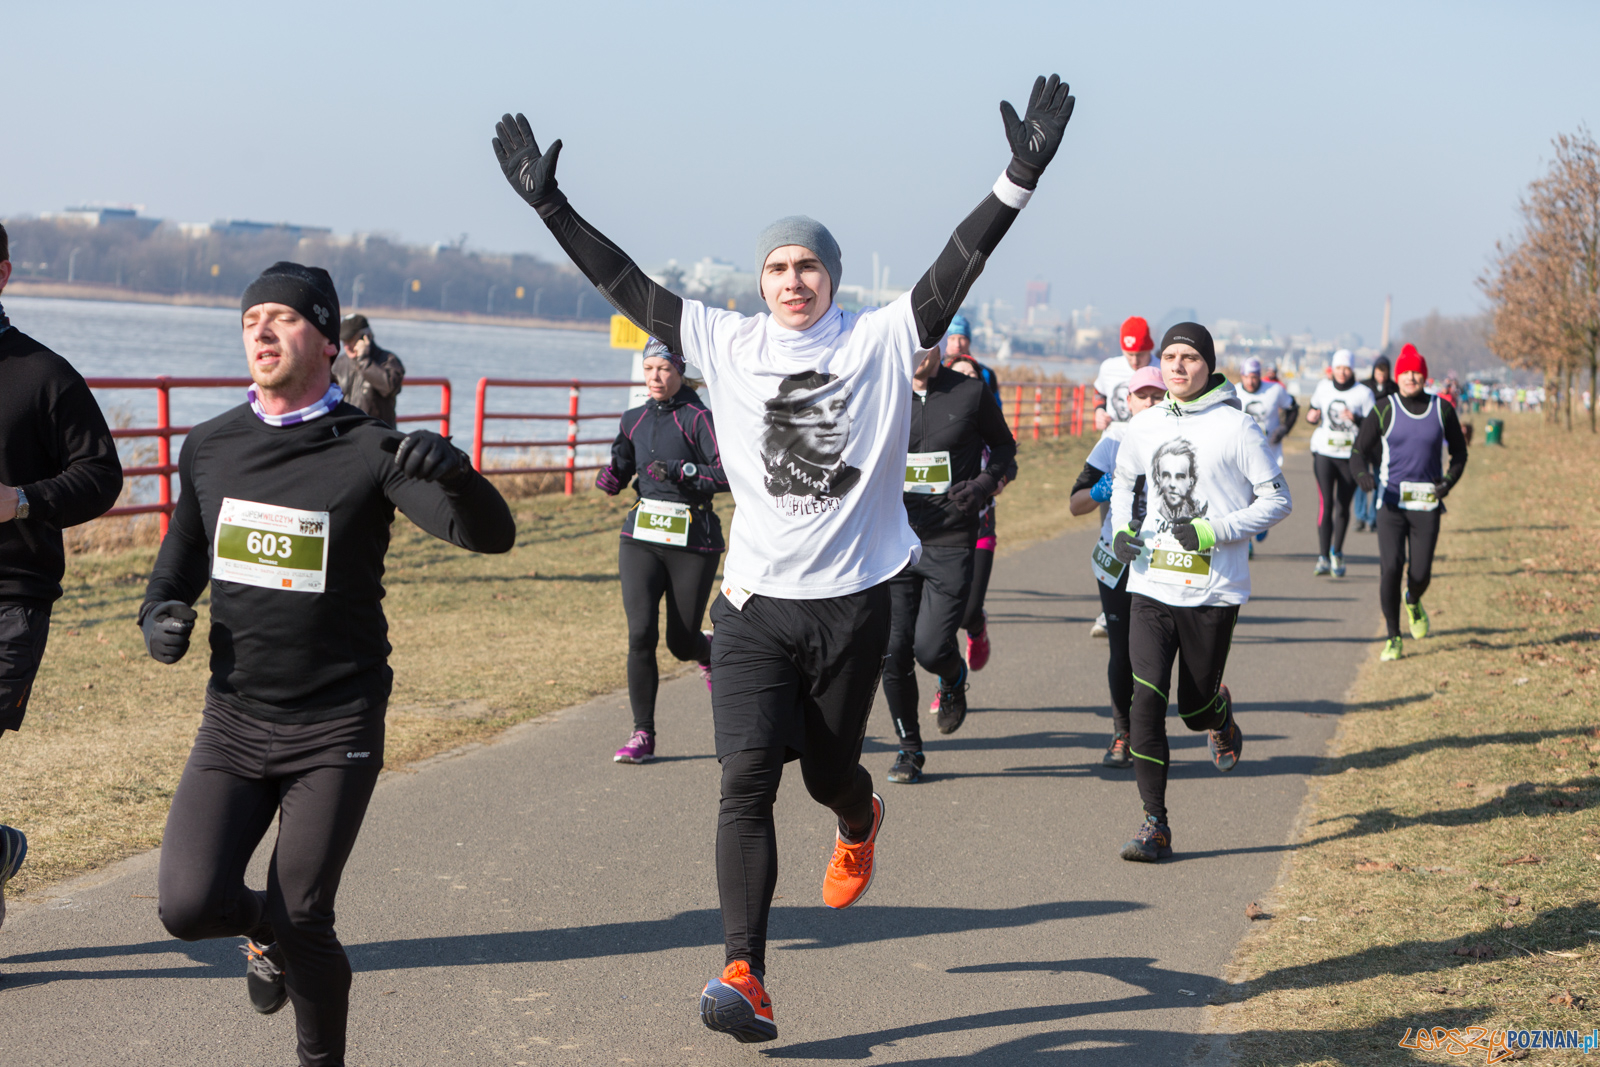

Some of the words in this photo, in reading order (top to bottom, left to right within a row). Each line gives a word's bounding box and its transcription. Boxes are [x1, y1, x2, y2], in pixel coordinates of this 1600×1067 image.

[913, 467, 930, 479] 77
[793, 498, 840, 516] PILECKI
[649, 514, 672, 529] 544
[246, 531, 292, 559] 603
[258, 557, 278, 565] Tomasz
[1096, 550, 1113, 568] 616
[1166, 552, 1193, 568] 926
